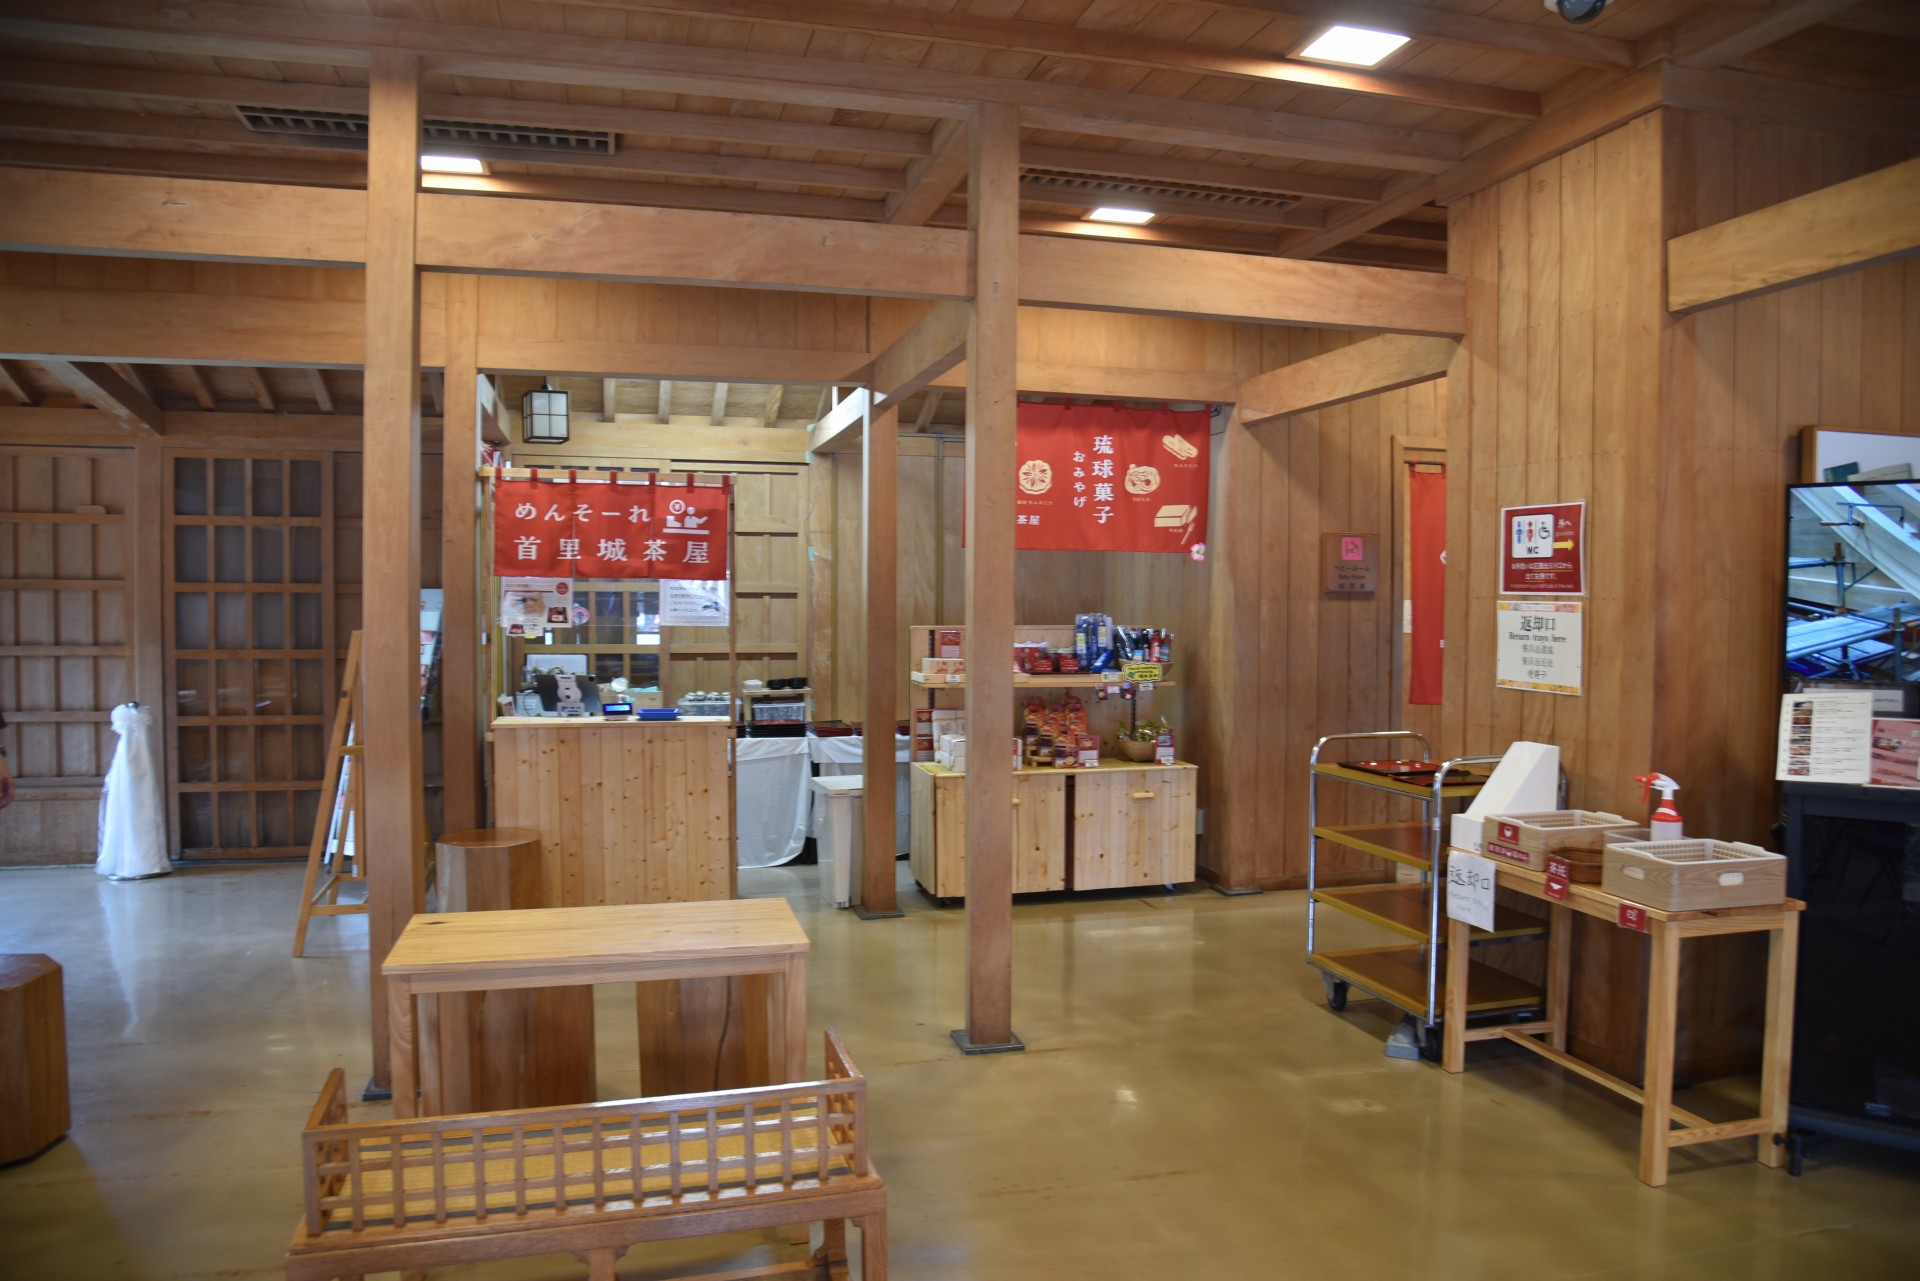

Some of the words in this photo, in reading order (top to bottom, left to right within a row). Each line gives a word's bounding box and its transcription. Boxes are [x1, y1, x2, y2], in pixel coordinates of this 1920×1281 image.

[1072, 450, 1088, 508] おみやげ
[1091, 434, 1115, 525] 琉球菓子
[514, 502, 652, 523] めんそーれ
[1016, 514, 1041, 526] 茶屋
[513, 535, 711, 564] 首里城茶屋
[1526, 546, 1540, 555] WC
[1519, 614, 1556, 632] 返却口
[1508, 631, 1530, 641] Return
[1551, 634, 1567, 643] here
[1449, 865, 1490, 893] 返却口
